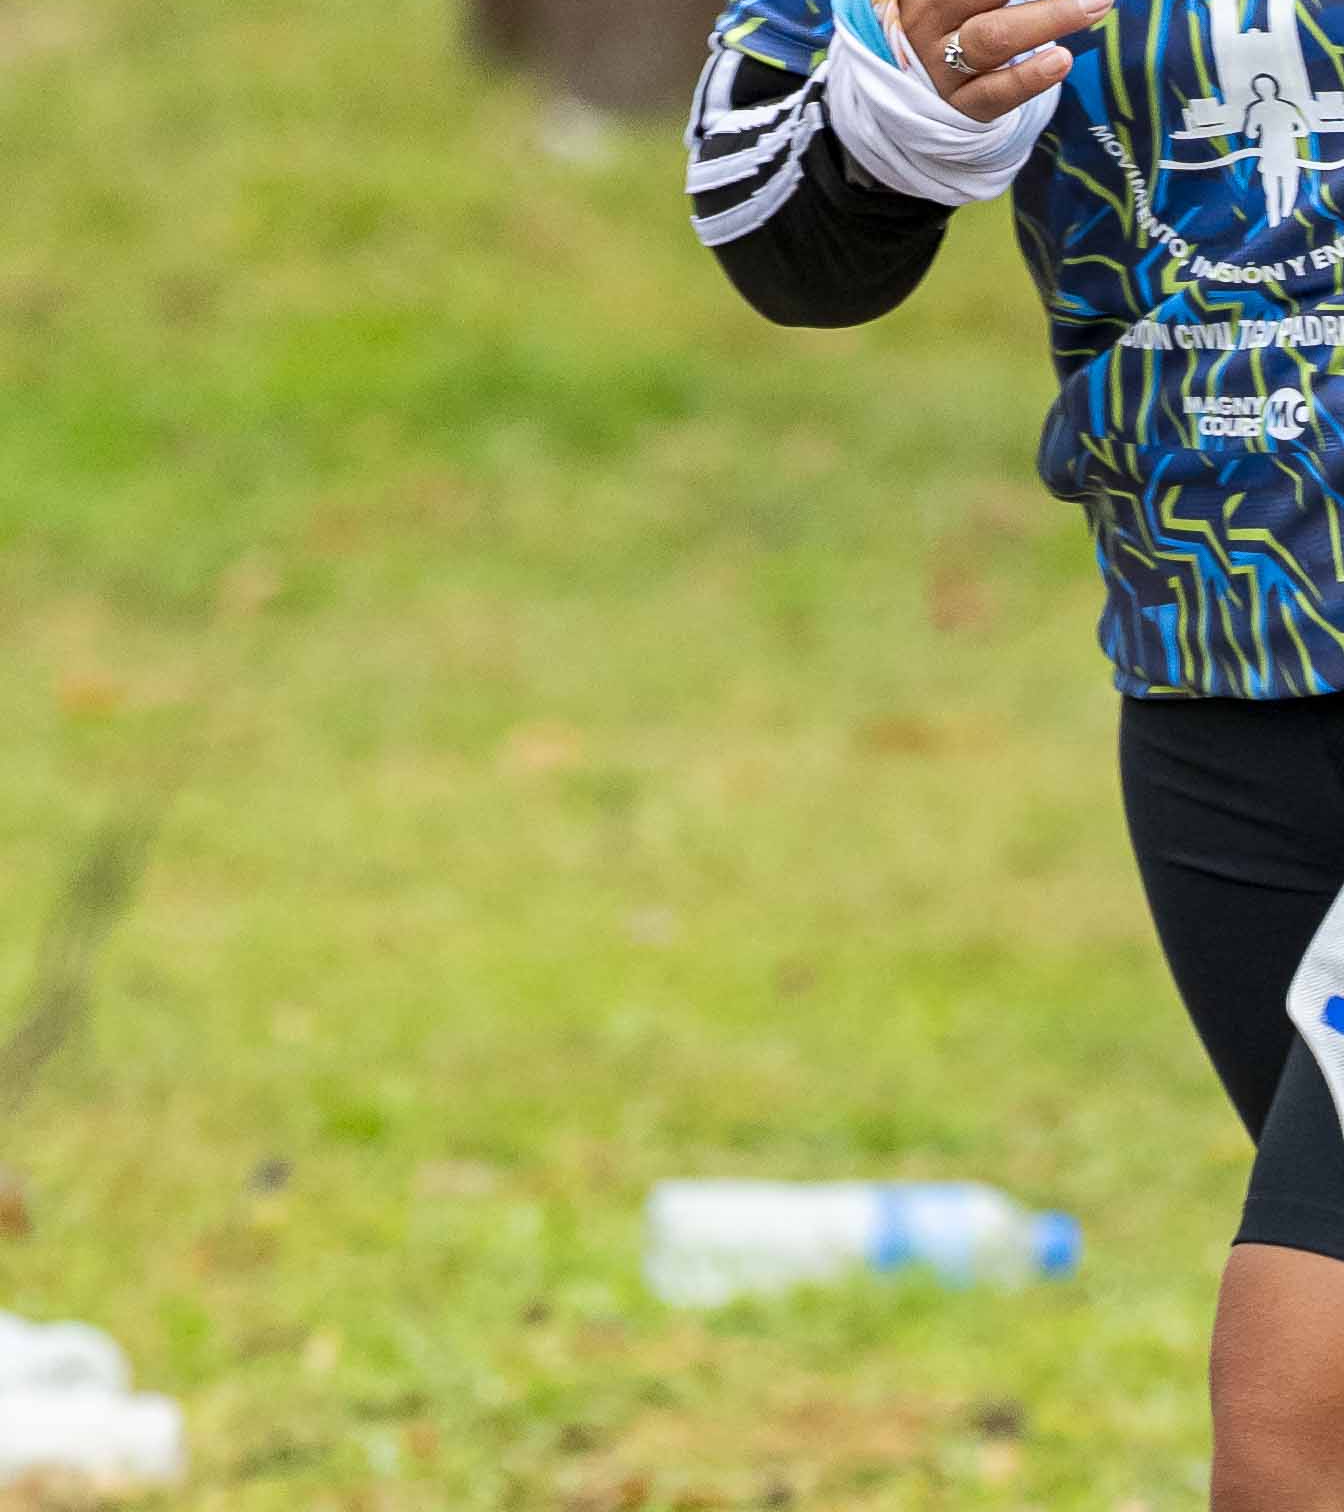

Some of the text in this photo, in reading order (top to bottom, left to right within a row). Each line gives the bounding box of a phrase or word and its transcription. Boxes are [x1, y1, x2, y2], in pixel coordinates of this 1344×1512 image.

[1285, 256, 1307, 276] Y
[1183, 396, 1267, 415] MAGNY
[1199, 415, 1262, 437] COURS
